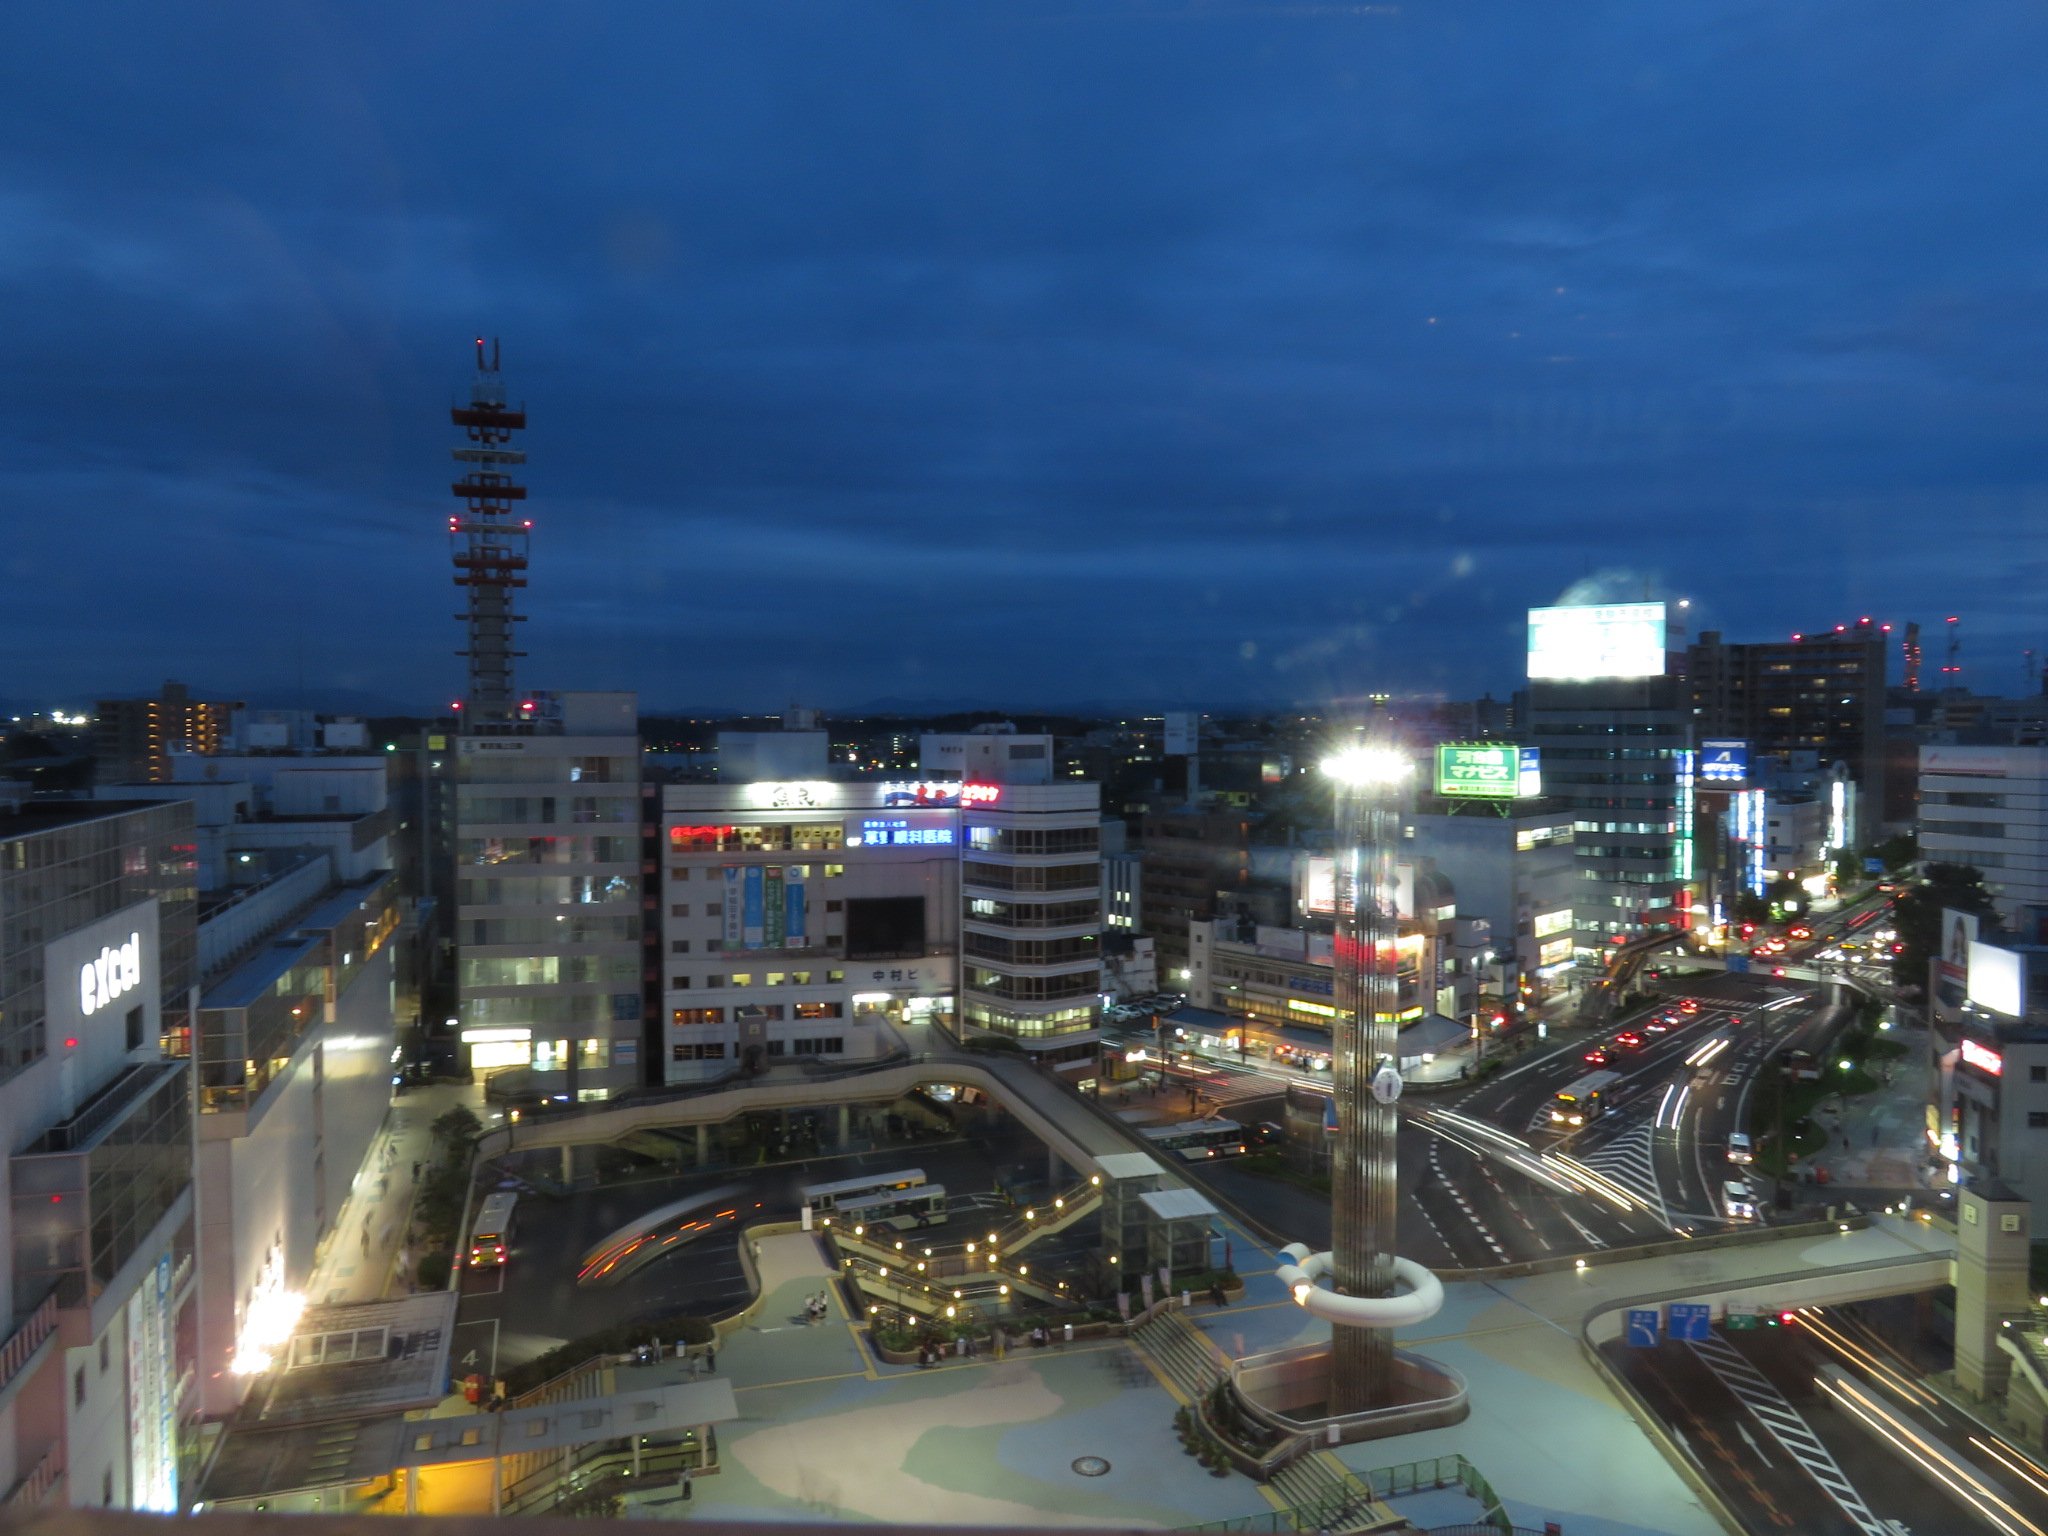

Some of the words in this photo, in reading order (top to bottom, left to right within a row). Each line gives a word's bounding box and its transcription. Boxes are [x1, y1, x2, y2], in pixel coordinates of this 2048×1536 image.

[1450, 766, 1509, 779] マナビス
[81, 932, 140, 1015] excel
[872, 968, 937, 982] 中村ビ
[461, 1350, 480, 1366] 4
